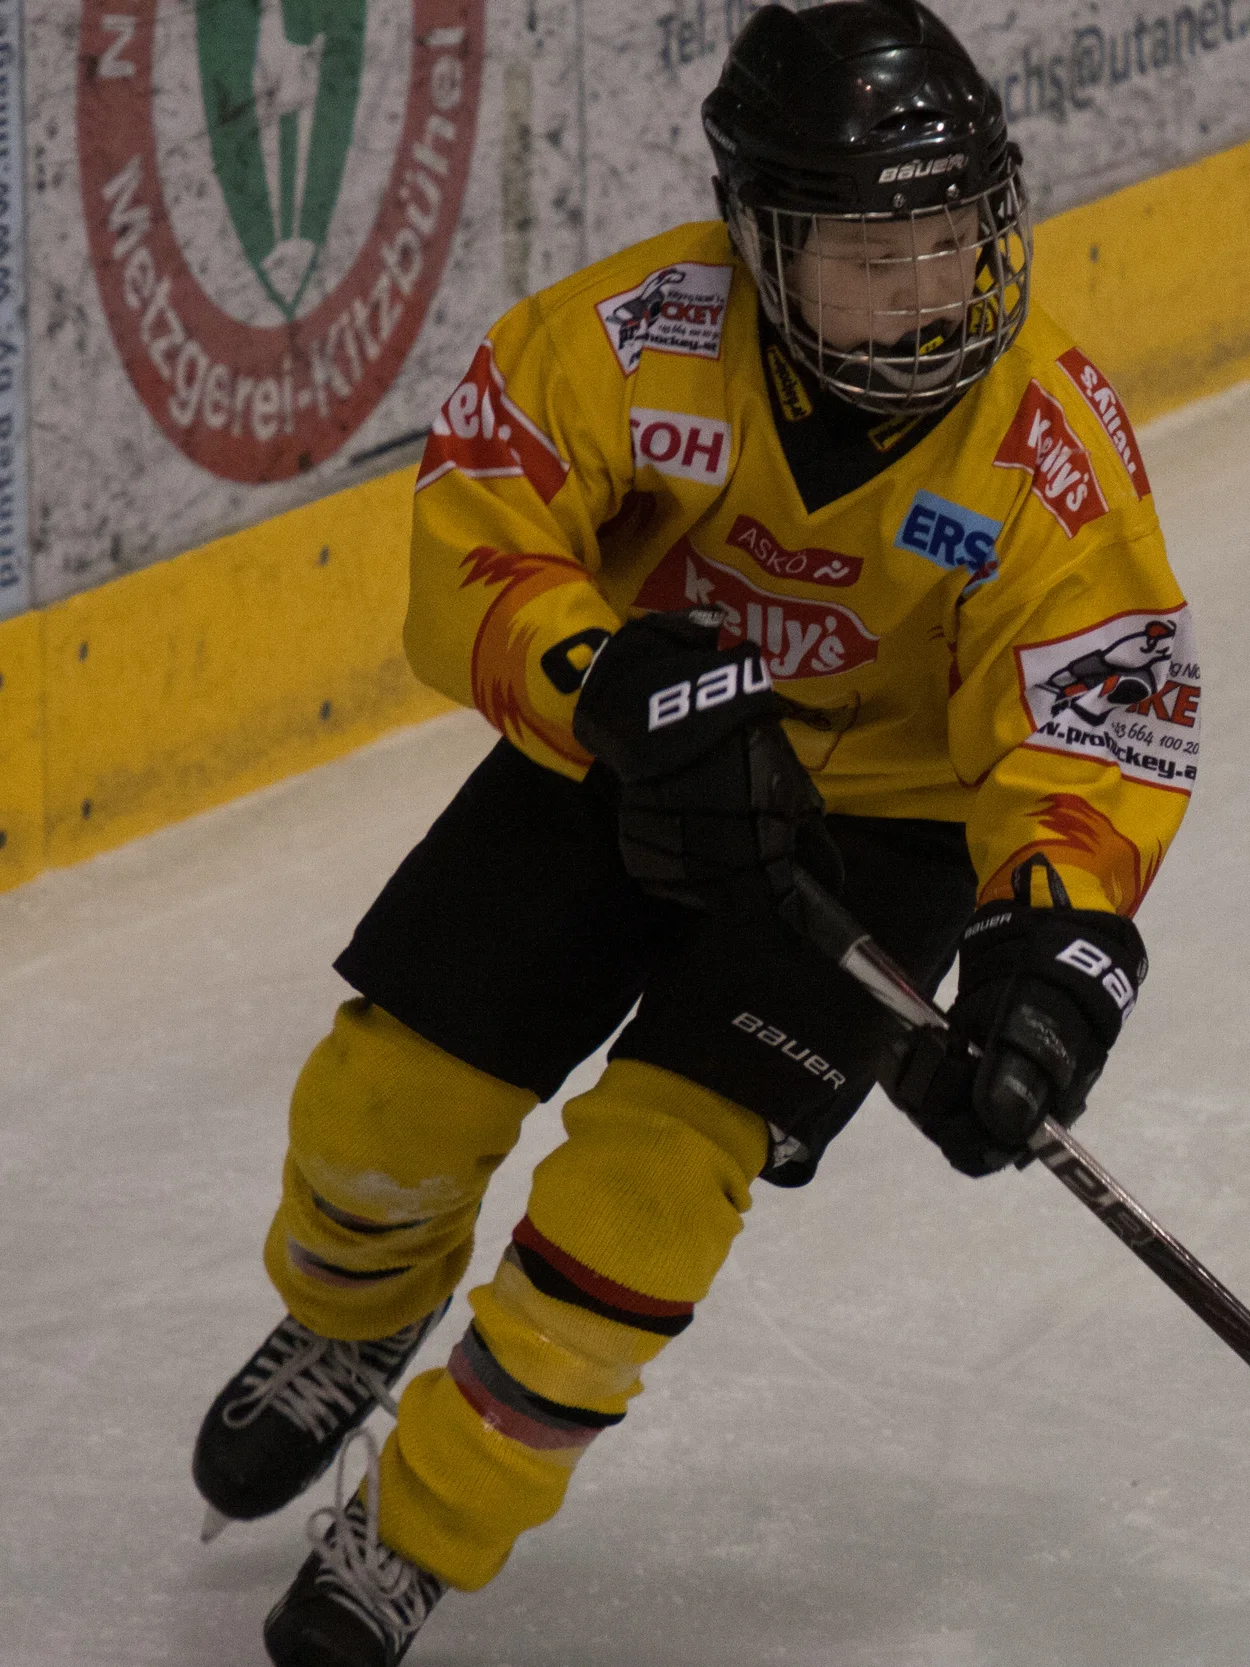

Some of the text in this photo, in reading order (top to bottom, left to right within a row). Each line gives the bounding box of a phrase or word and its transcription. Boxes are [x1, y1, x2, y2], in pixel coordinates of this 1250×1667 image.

[630, 418, 724, 473] OH
[1027, 409, 1089, 511] Kelly's
[1128, 722, 1154, 746] 664
[1159, 735, 1183, 752] 100
[732, 1011, 846, 1090] BAUER
